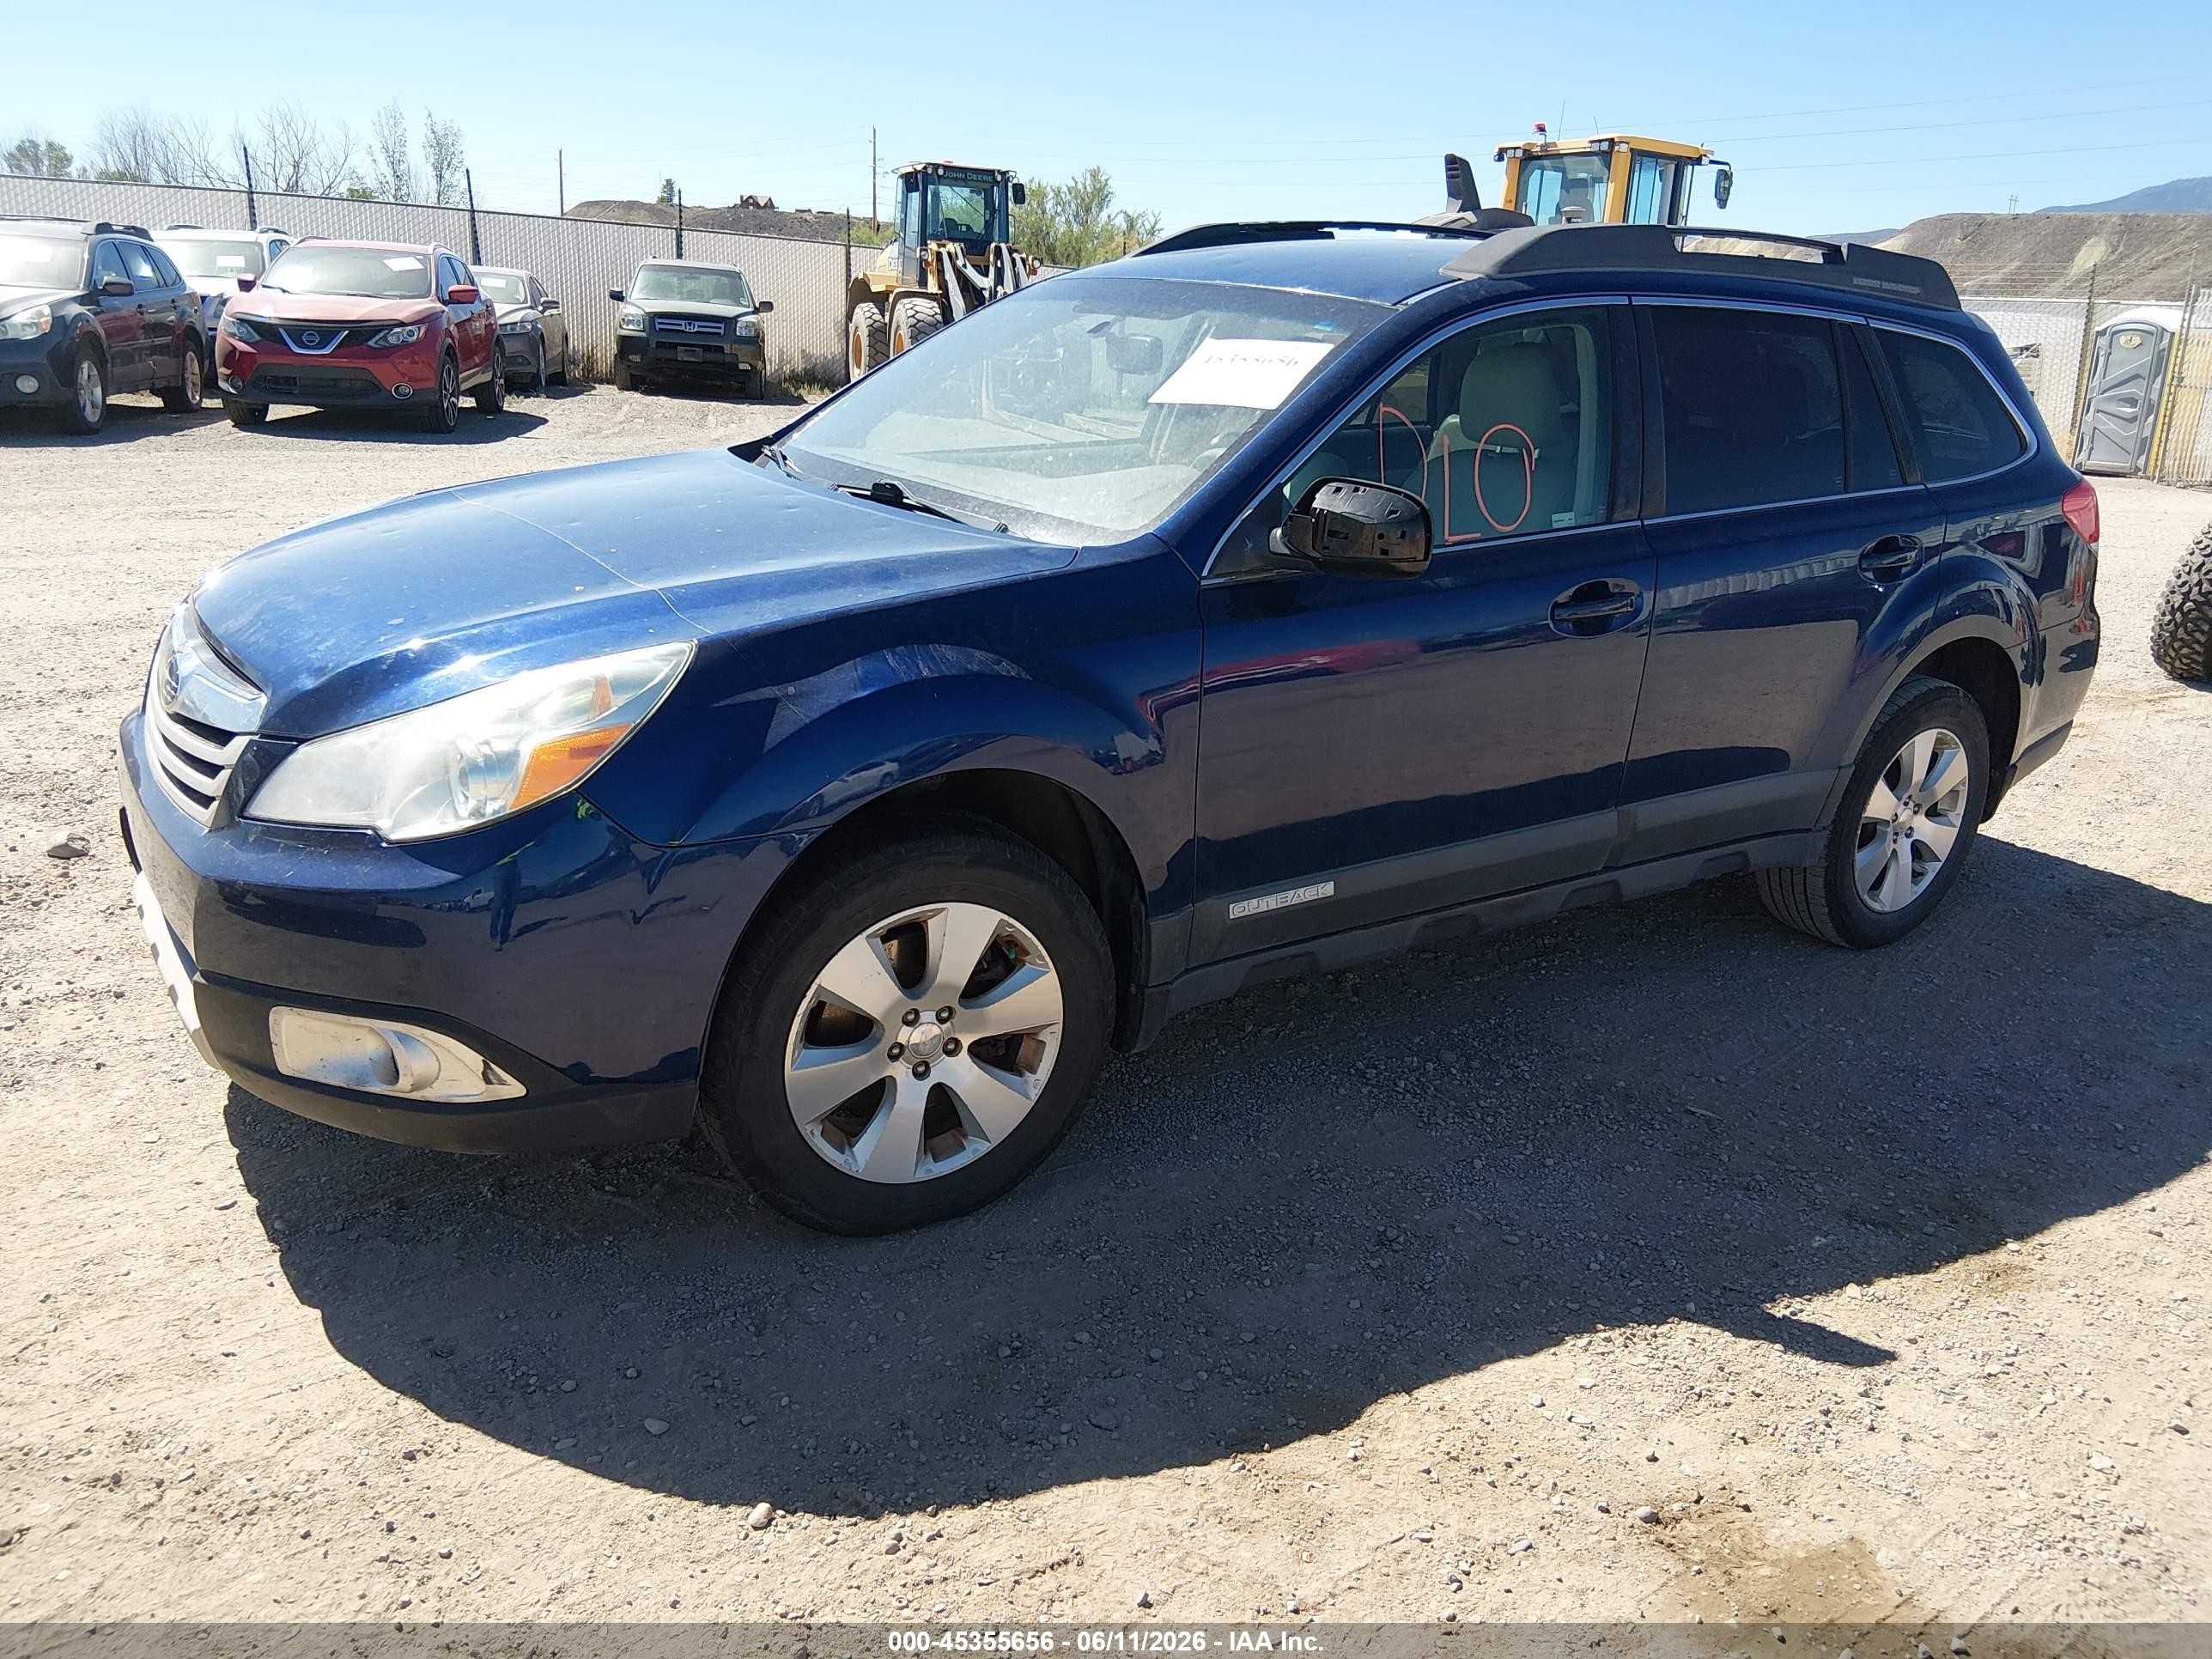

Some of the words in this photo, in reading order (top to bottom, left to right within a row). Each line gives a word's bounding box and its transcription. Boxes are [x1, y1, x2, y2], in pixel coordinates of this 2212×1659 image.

[943, 170, 965, 179] JOHN
[966, 172, 994, 182] DEERE
[1231, 882, 1331, 917] OUTBACK
